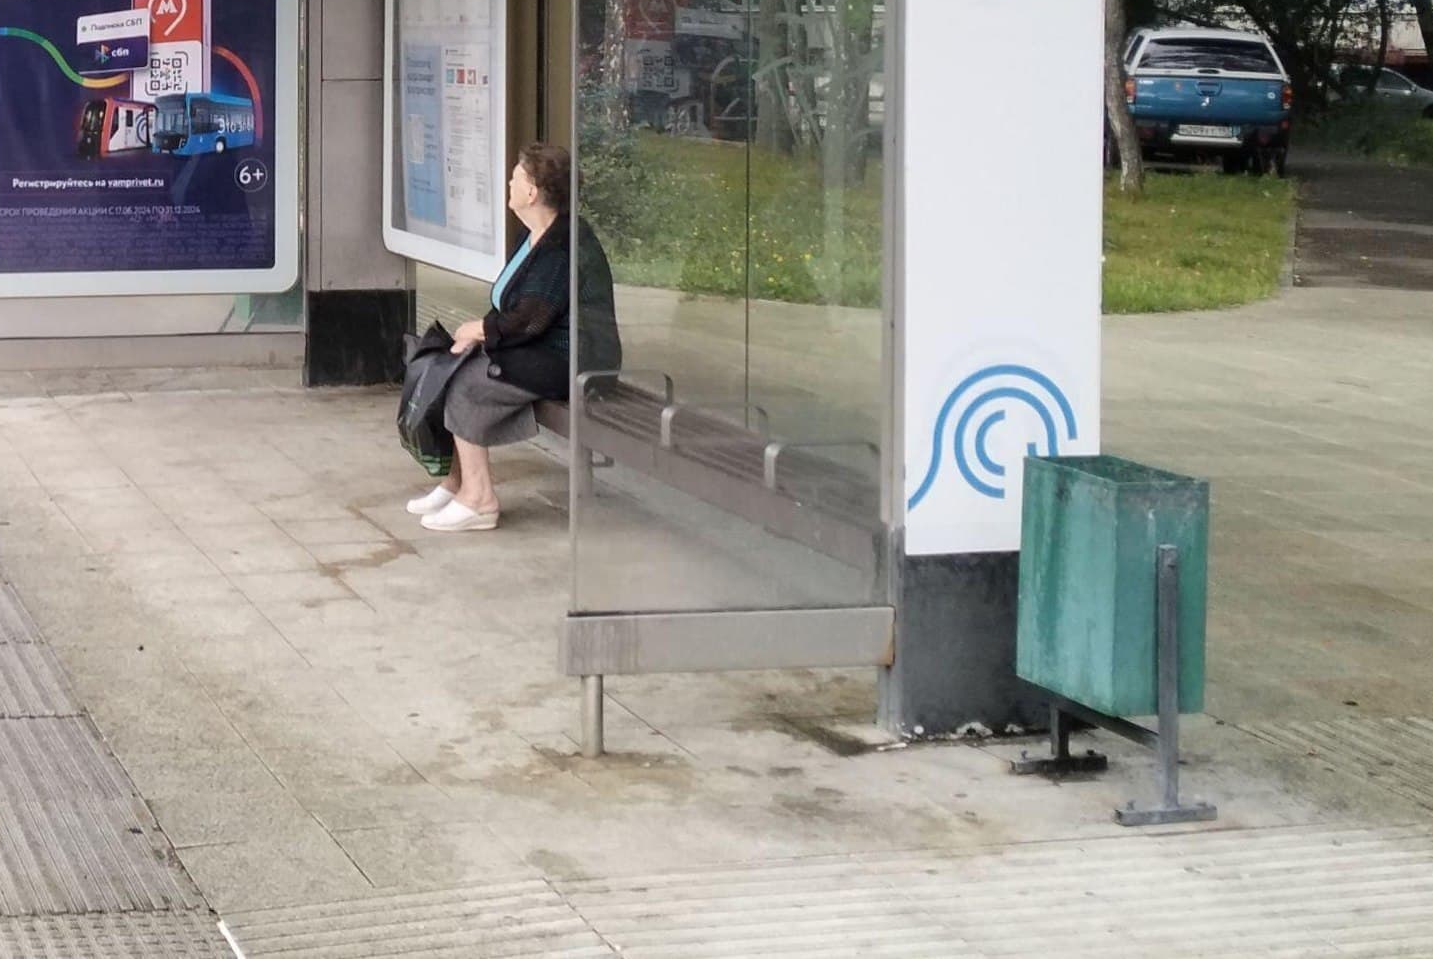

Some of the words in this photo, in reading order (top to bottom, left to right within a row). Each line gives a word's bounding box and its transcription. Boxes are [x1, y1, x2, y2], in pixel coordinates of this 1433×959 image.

[238, 165, 265, 185] 6+
[12, 178, 94, 189] Регистрируйтесь
[95, 179, 106, 187] на
